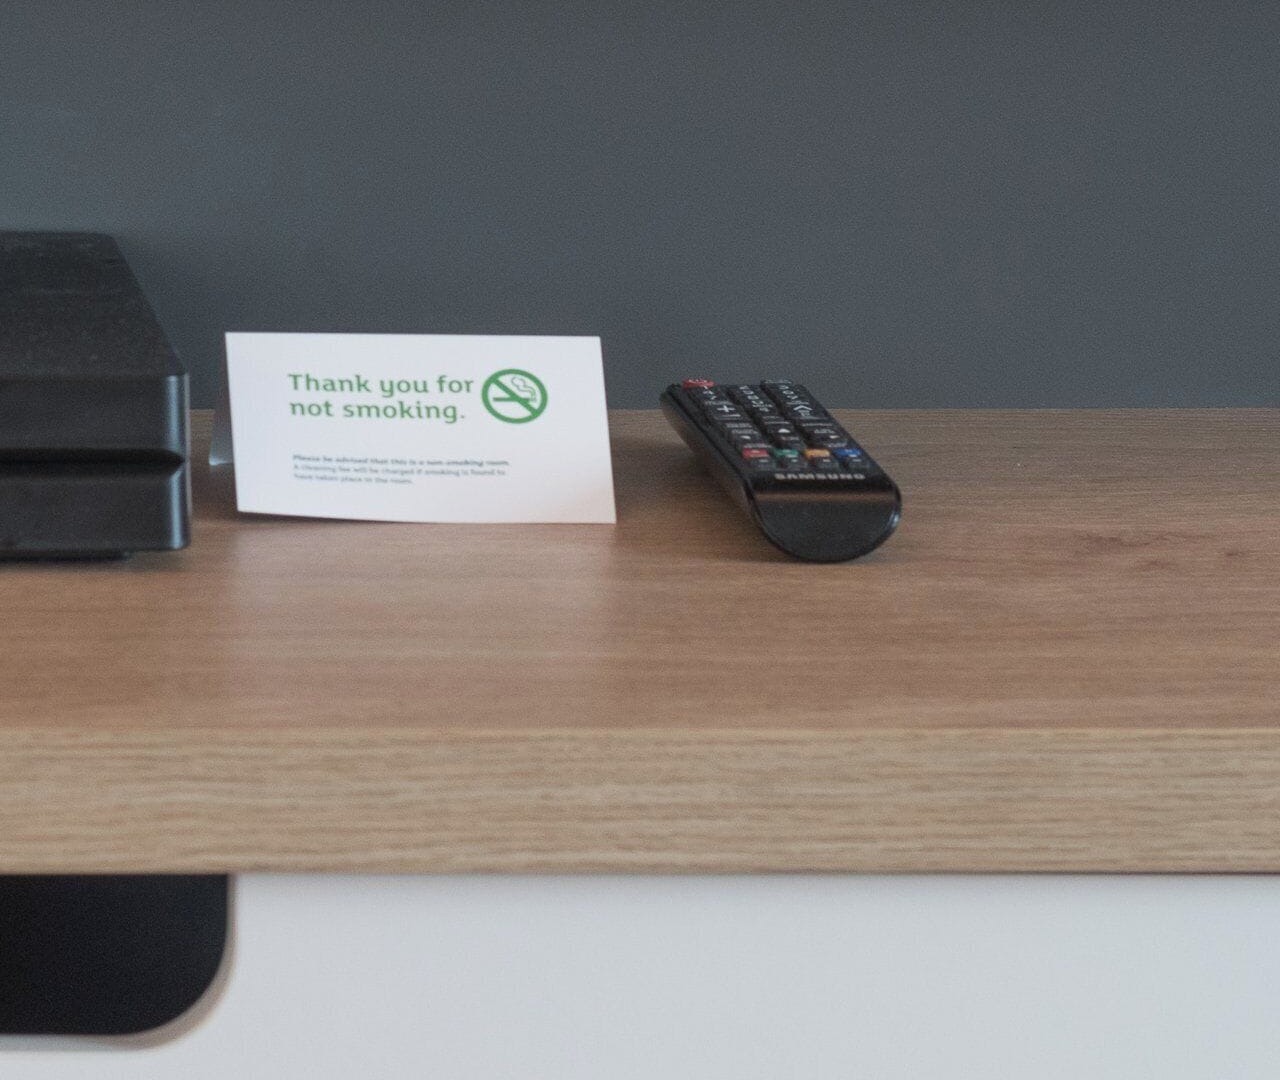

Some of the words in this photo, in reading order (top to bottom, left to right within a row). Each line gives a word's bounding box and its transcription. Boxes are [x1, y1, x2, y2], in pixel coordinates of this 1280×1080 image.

[287, 373, 372, 392] Thank
[379, 378, 429, 398] you
[436, 375, 474, 393] for
[290, 400, 334, 417] not
[343, 401, 466, 424] smoking.
[773, 472, 866, 480] SAMSUNG
